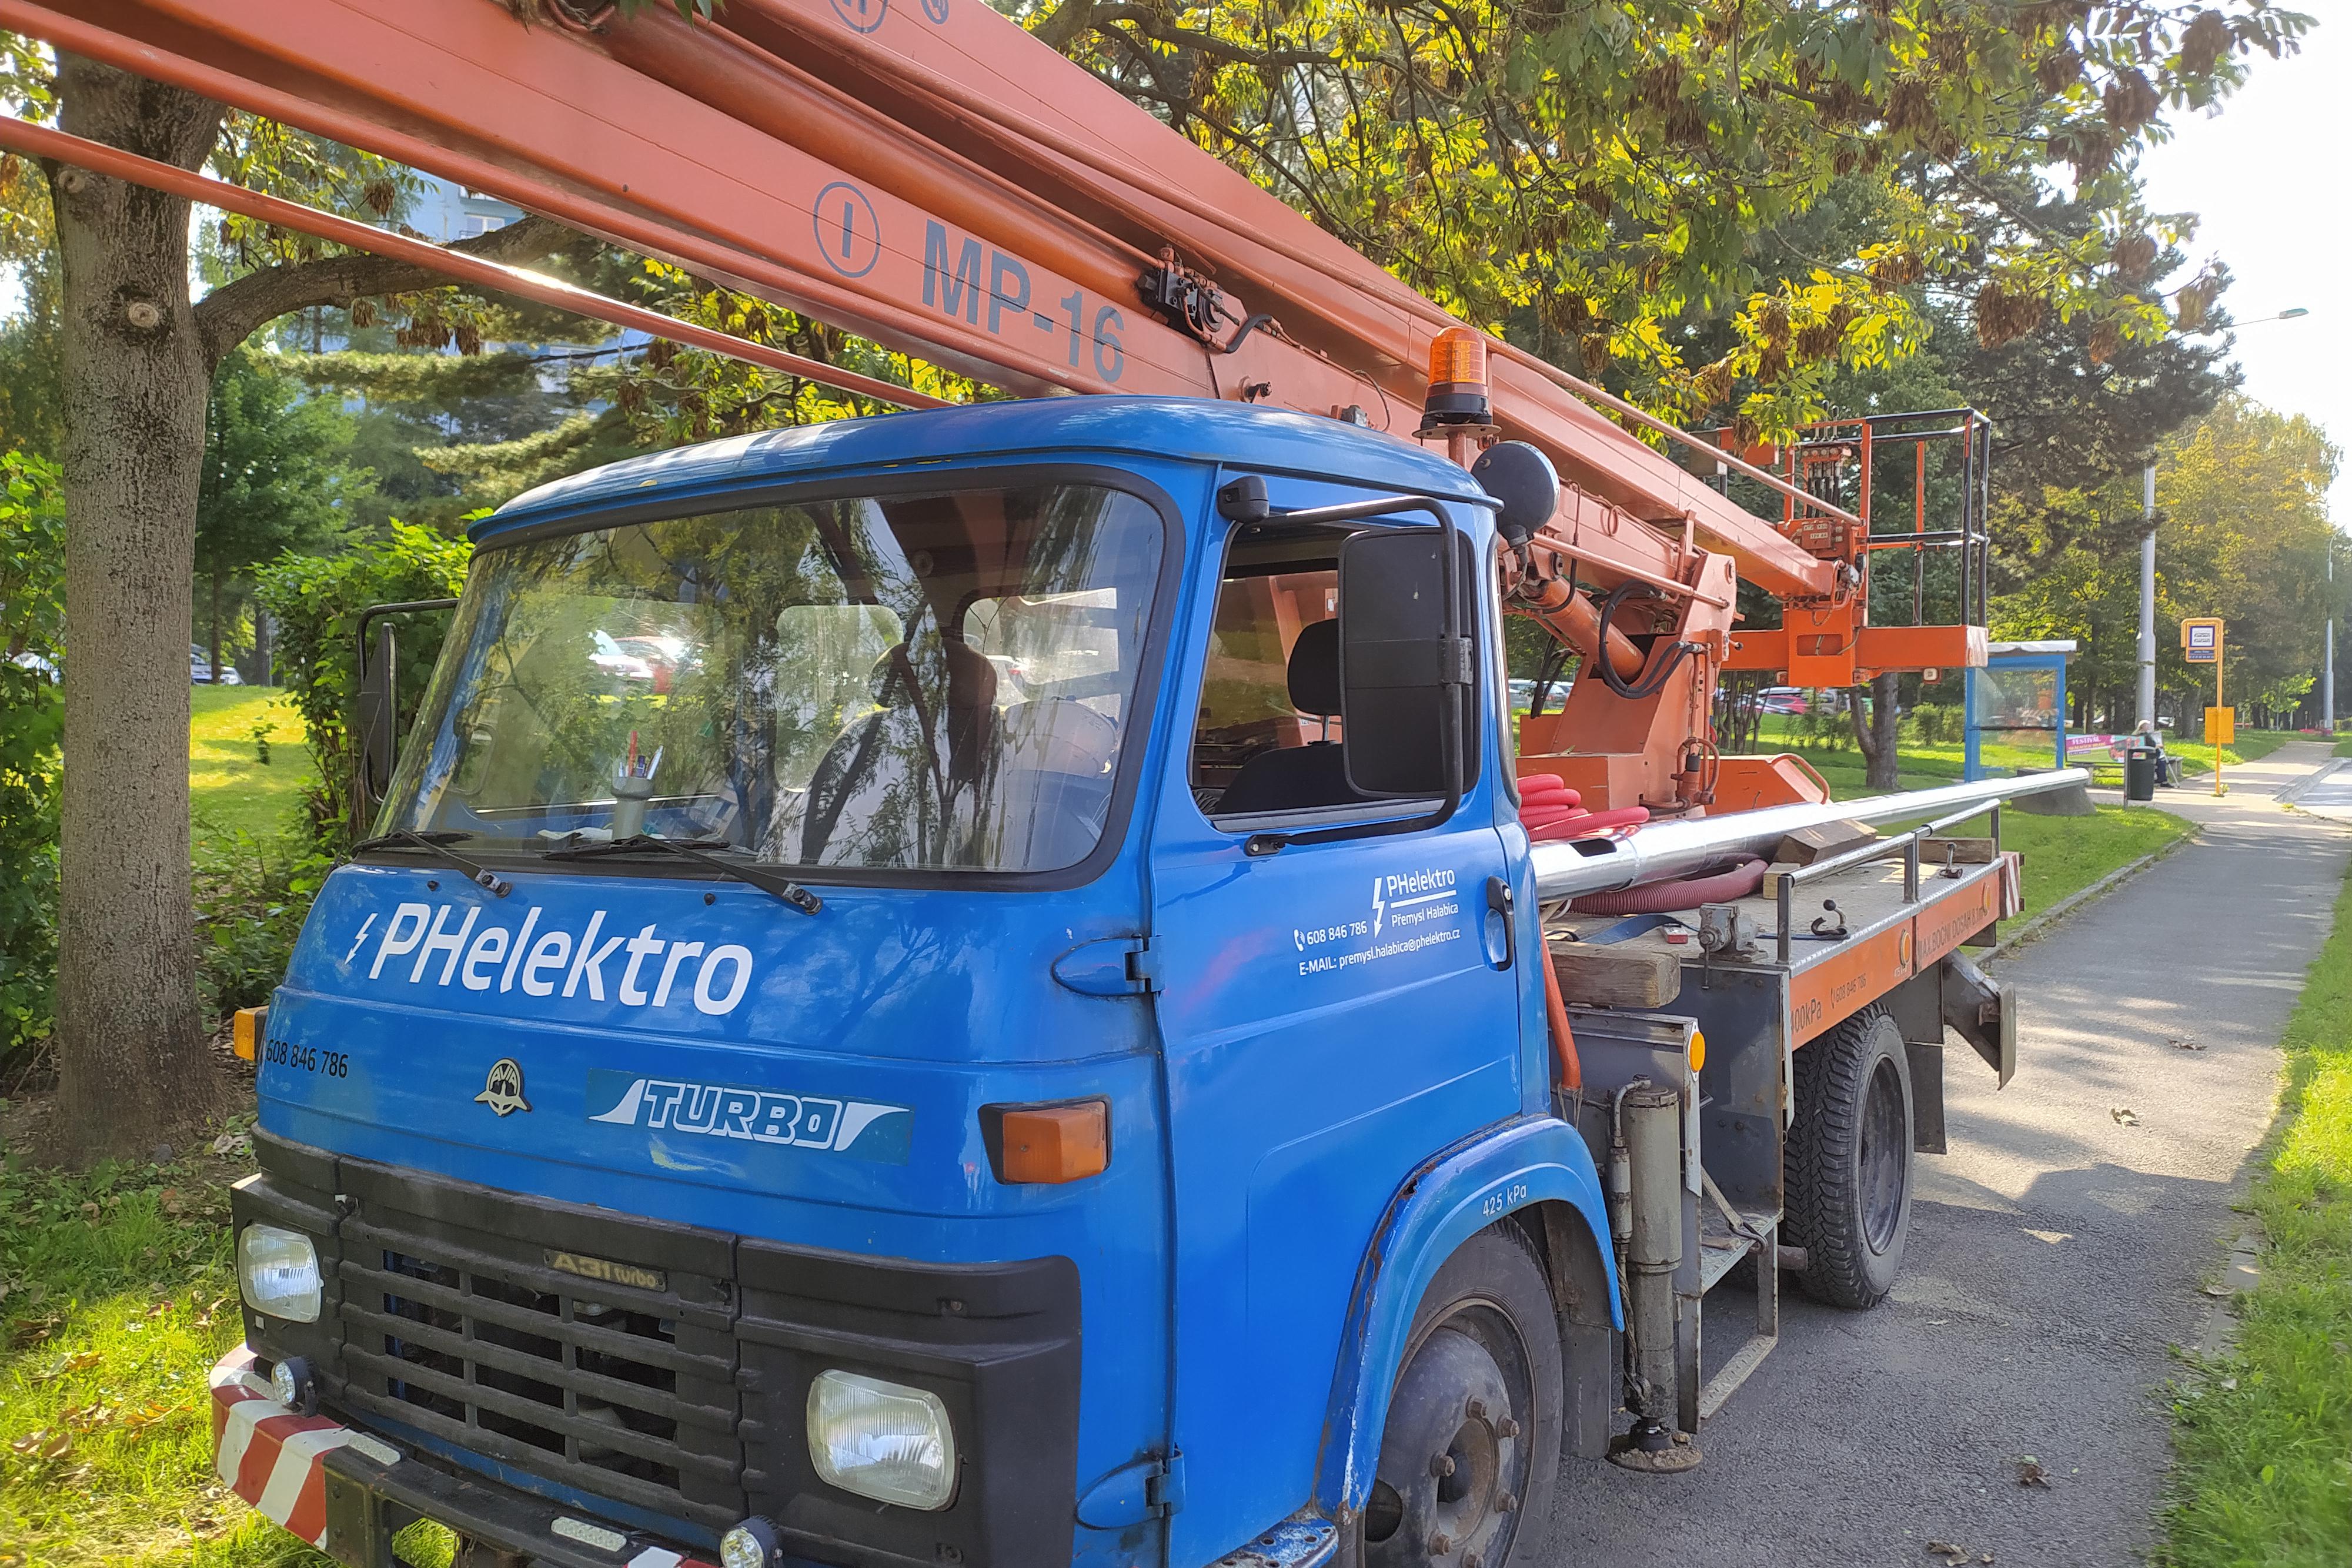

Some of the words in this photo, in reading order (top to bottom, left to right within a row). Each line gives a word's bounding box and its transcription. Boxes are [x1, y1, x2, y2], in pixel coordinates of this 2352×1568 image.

[921, 219, 1125, 383] MP-16
[1386, 868, 1455, 897] PHelektro
[1307, 929, 1327, 945] 608
[1328, 924, 1348, 941] 846
[1348, 920, 1368, 937] 786
[1391, 908, 1425, 928] Přemysl
[1426, 902, 1459, 920] Halabica
[368, 902, 753, 1015] PHelektro
[1299, 956, 1337, 976] E-MAIL:
[1339, 929, 1461, 970] premysl.halabica@phelektro.cz
[1835, 985, 1846, 1003] 608
[266, 1039, 288, 1065] 608
[290, 1044, 317, 1072] 846
[320, 1050, 349, 1078] 786
[644, 1079, 844, 1150] TURBO
[1482, 1192, 1503, 1217] 425
[1506, 1185, 1527, 1206] kPa
[553, 1253, 611, 1280] A31
[613, 1266, 656, 1288] turbo
